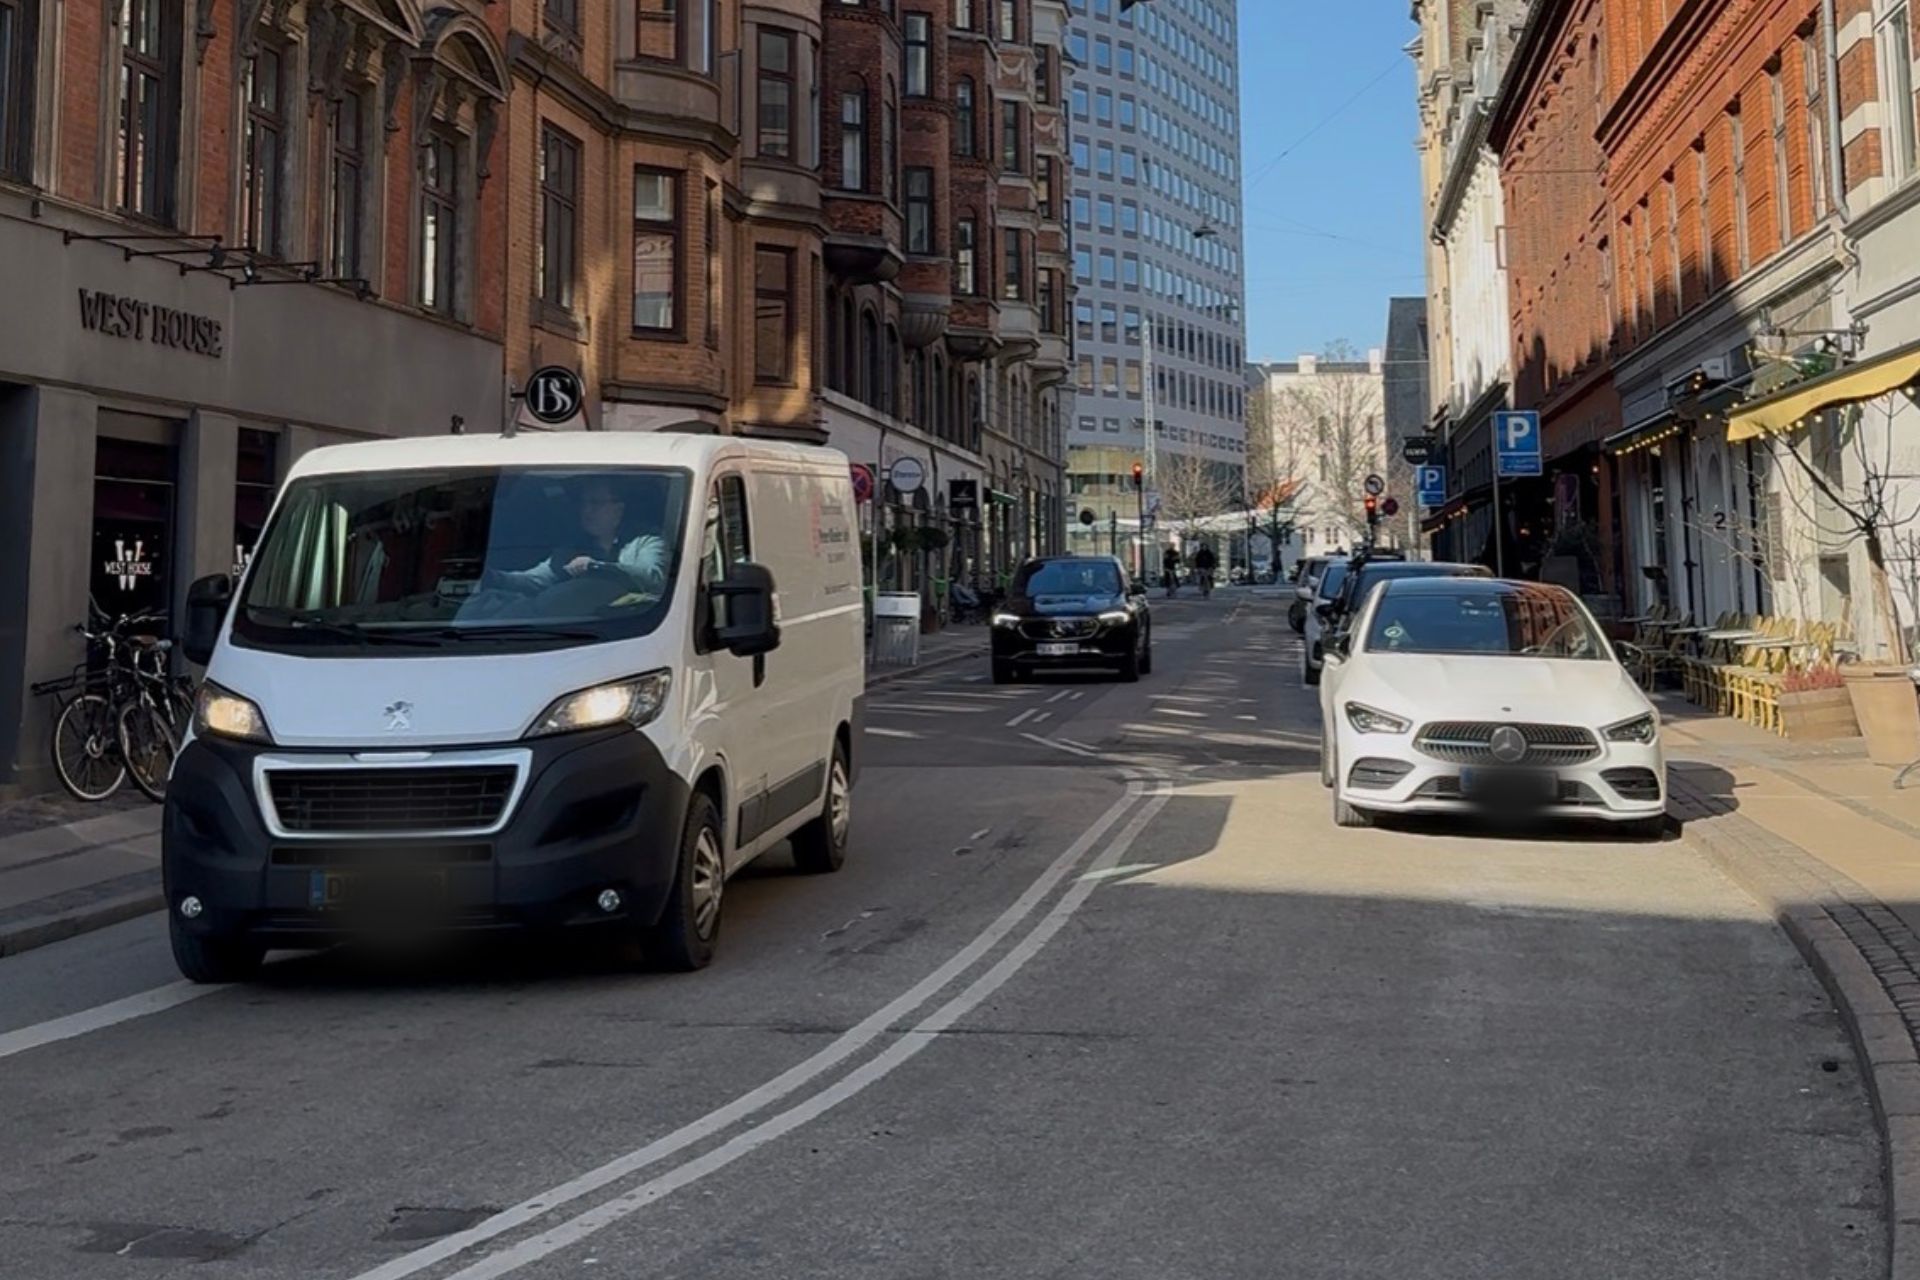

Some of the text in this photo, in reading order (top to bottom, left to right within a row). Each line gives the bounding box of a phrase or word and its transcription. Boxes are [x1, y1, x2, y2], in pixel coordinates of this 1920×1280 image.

[78, 288, 223, 359] WEST HOUSE
[1507, 416, 1531, 449] P
[1424, 469, 1439, 490] P
[1713, 511, 1727, 530] 2
[104, 561, 152, 576] WEST HOUSE
